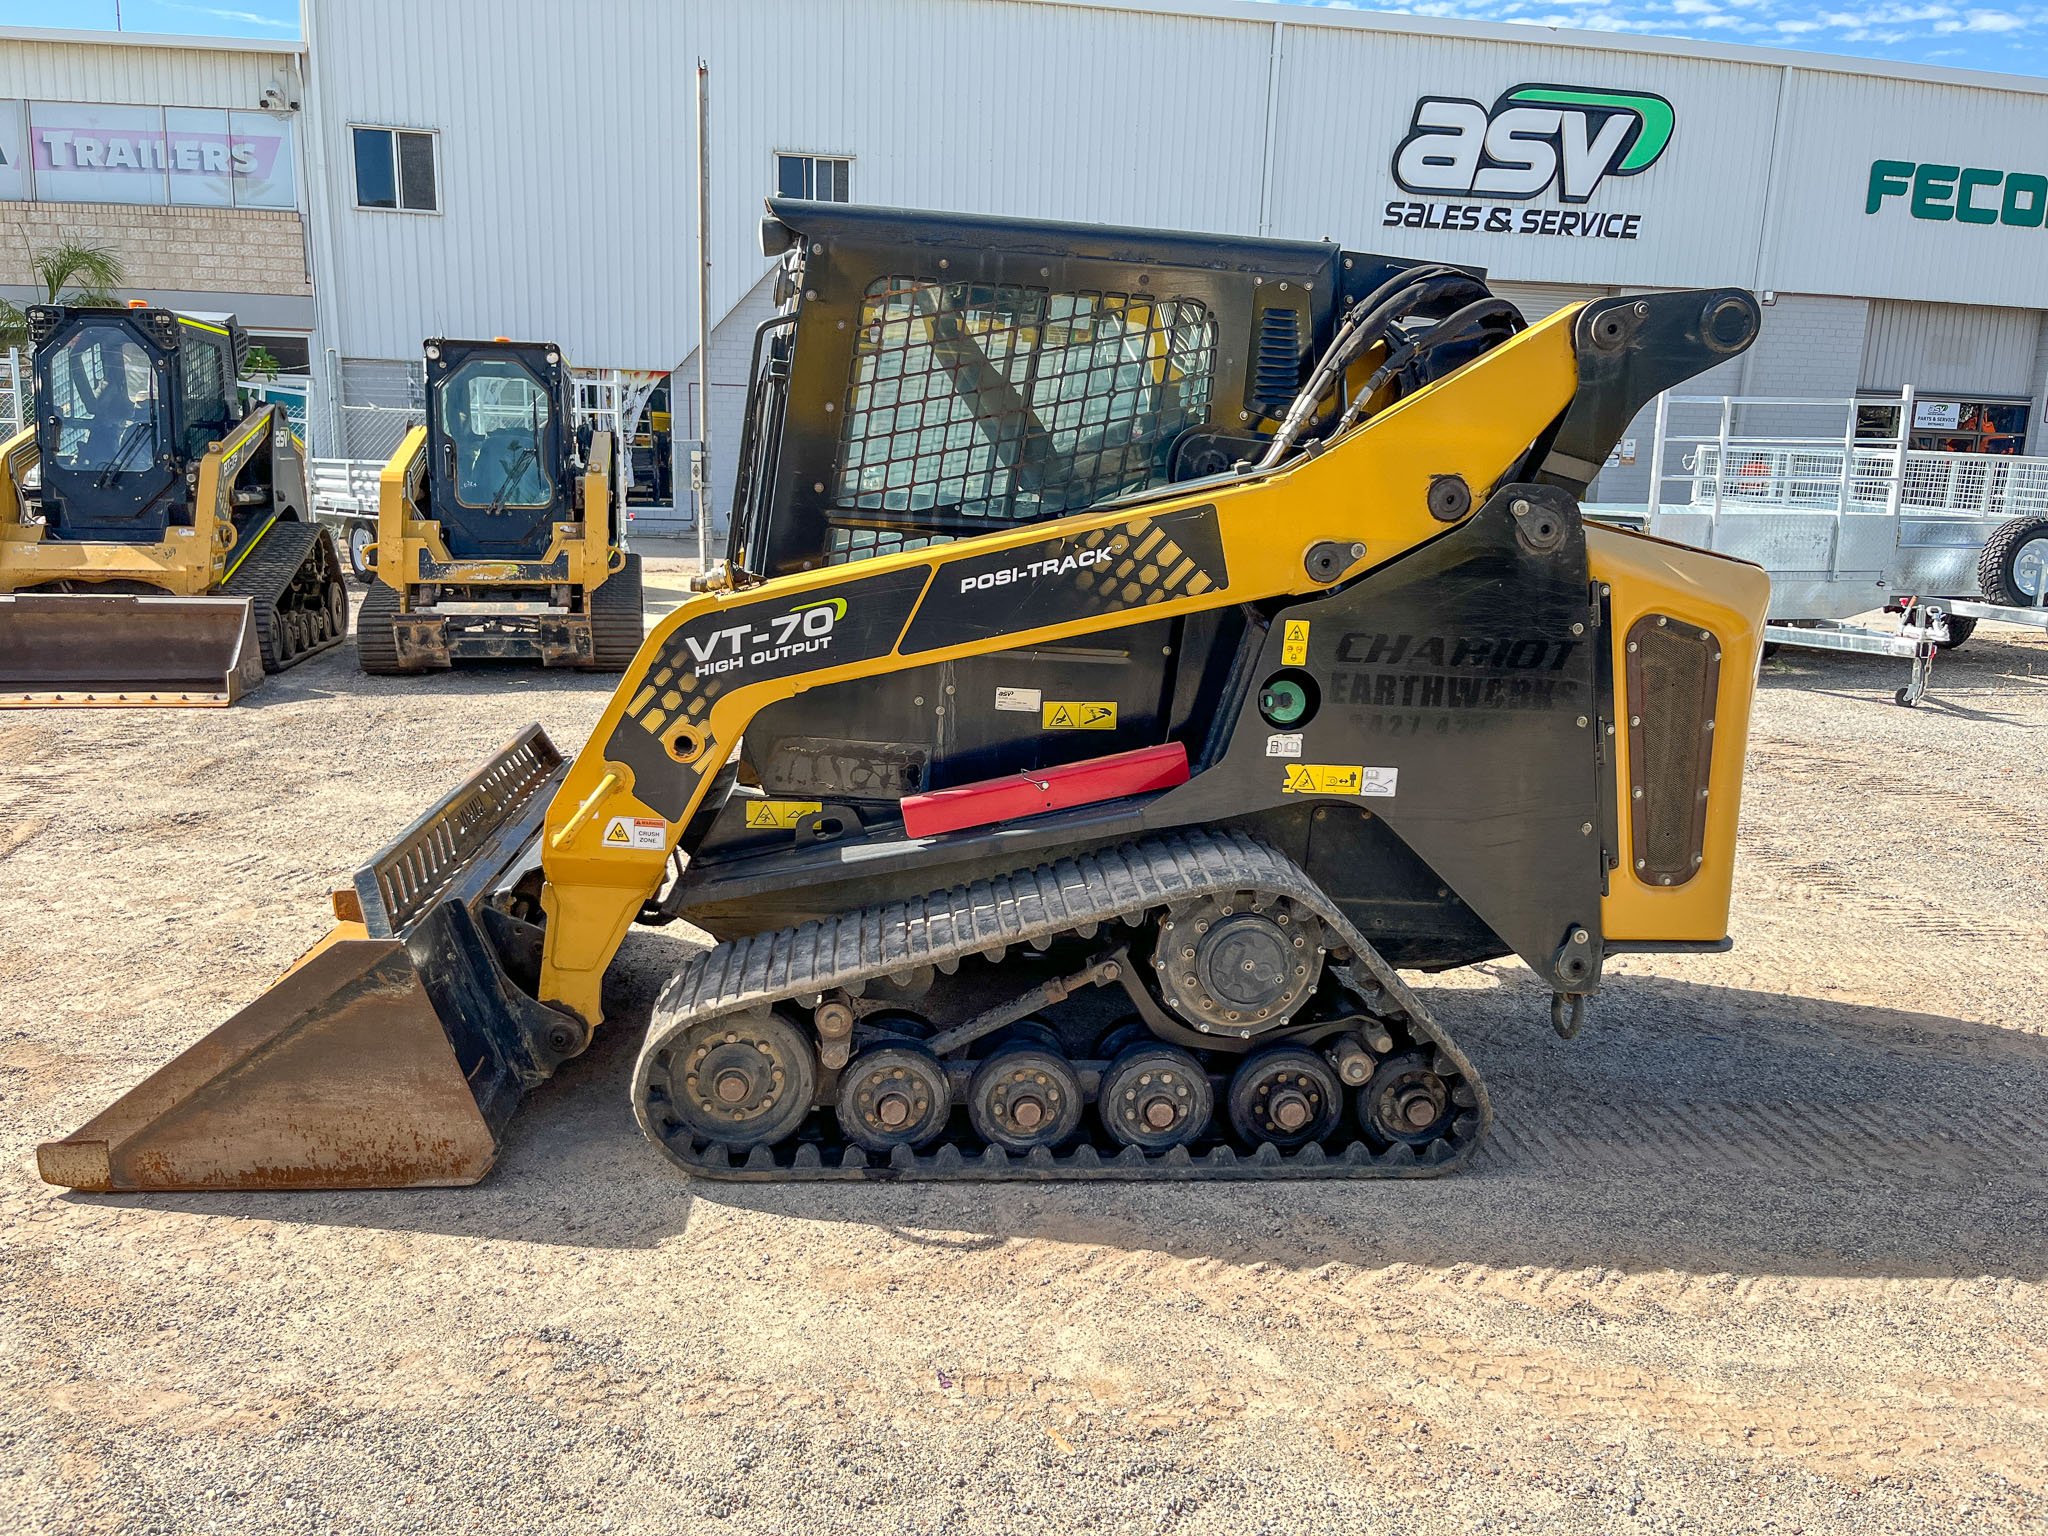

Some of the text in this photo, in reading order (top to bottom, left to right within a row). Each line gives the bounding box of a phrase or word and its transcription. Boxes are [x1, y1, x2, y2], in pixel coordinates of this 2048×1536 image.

[42, 130, 259, 174] TRAILERS
[1865, 159, 2048, 228] FECO
[1484, 207, 1514, 233] &
[1519, 209, 1642, 239] SERVICE
[685, 606, 834, 663] VT-70
[1335, 632, 1584, 671] CHARIOT
[695, 636, 833, 678] HIGH OUTPUT
